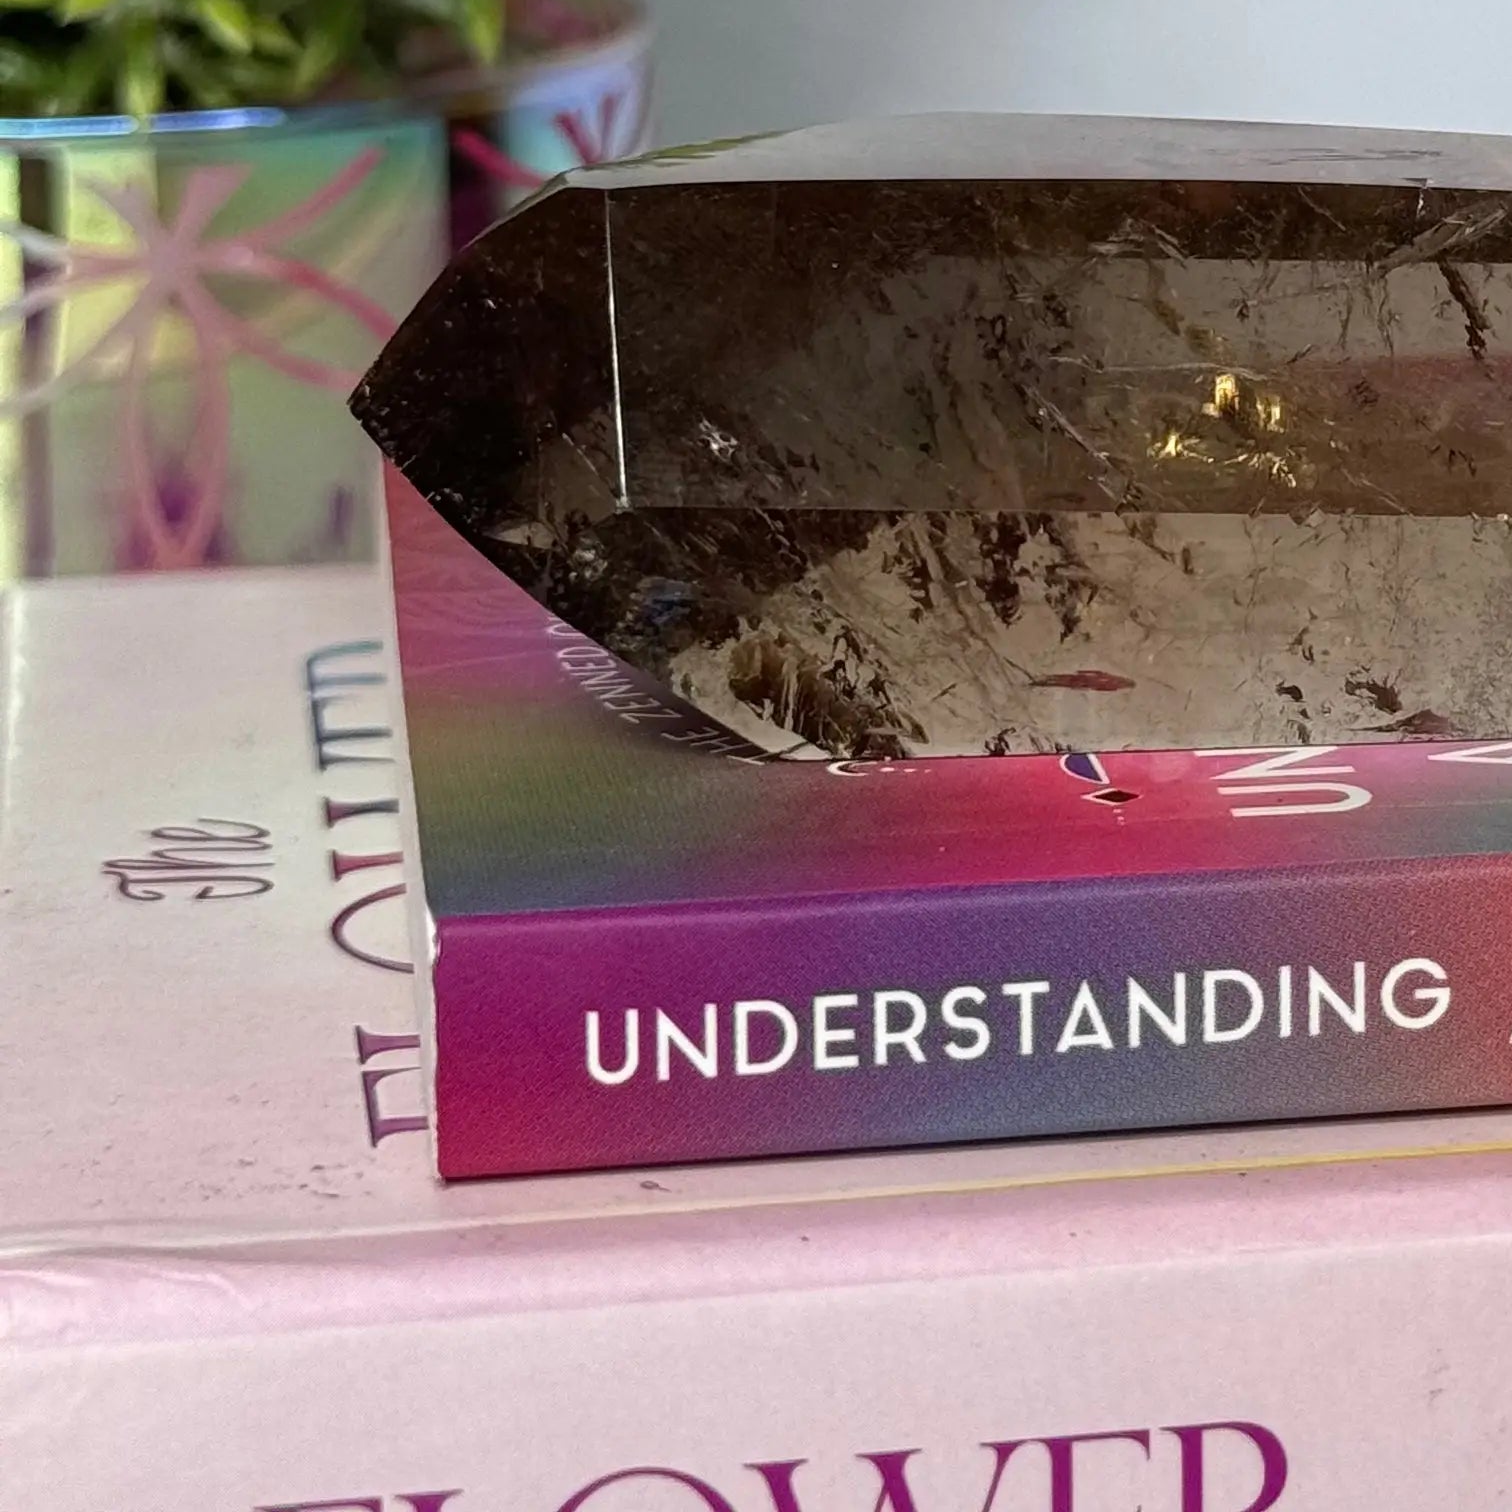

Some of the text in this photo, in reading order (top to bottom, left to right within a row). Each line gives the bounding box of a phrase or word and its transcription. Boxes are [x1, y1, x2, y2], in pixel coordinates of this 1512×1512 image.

[557, 646, 683, 725] ZENNED
[100, 818, 274, 901] The
[584, 959, 1451, 1086] UNDERSTANDING
